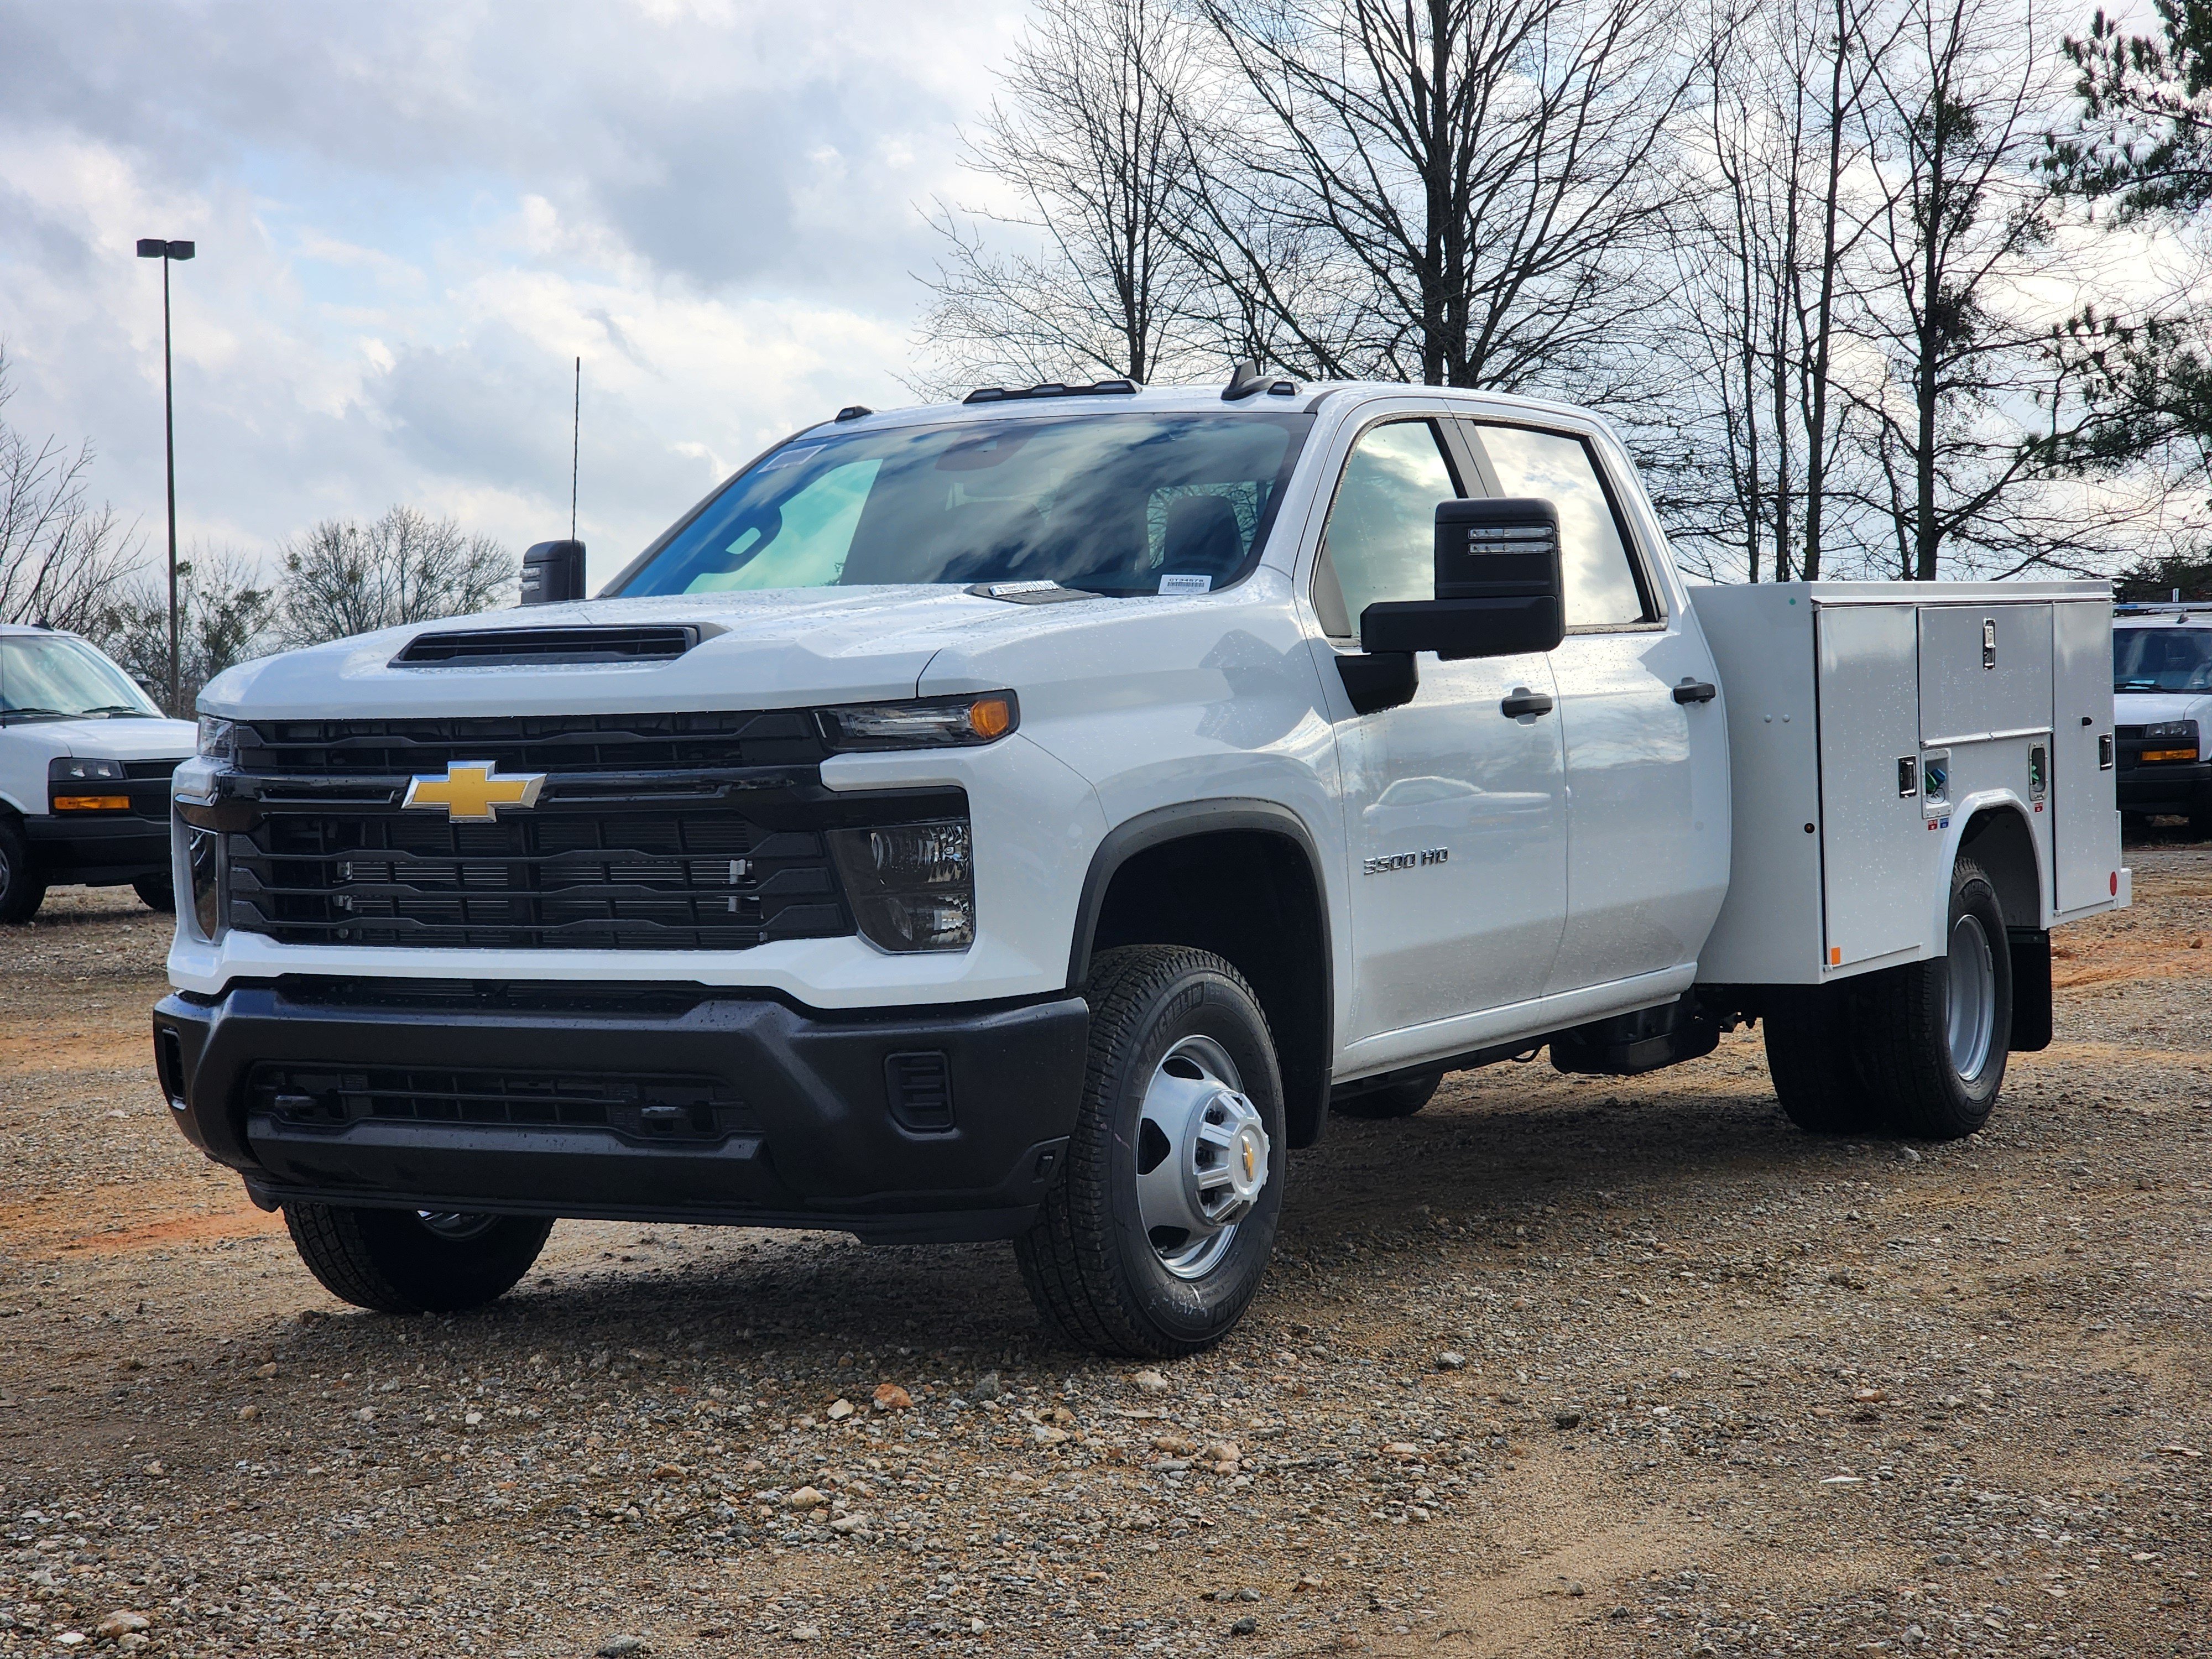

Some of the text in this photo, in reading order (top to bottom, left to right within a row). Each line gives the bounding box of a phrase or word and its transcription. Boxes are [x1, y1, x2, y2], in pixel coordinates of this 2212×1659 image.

[1016, 580, 1060, 593] DURAMAX
[1364, 847, 1448, 875] 3500 HD
[1144, 985, 1203, 1063] MICHELIN
